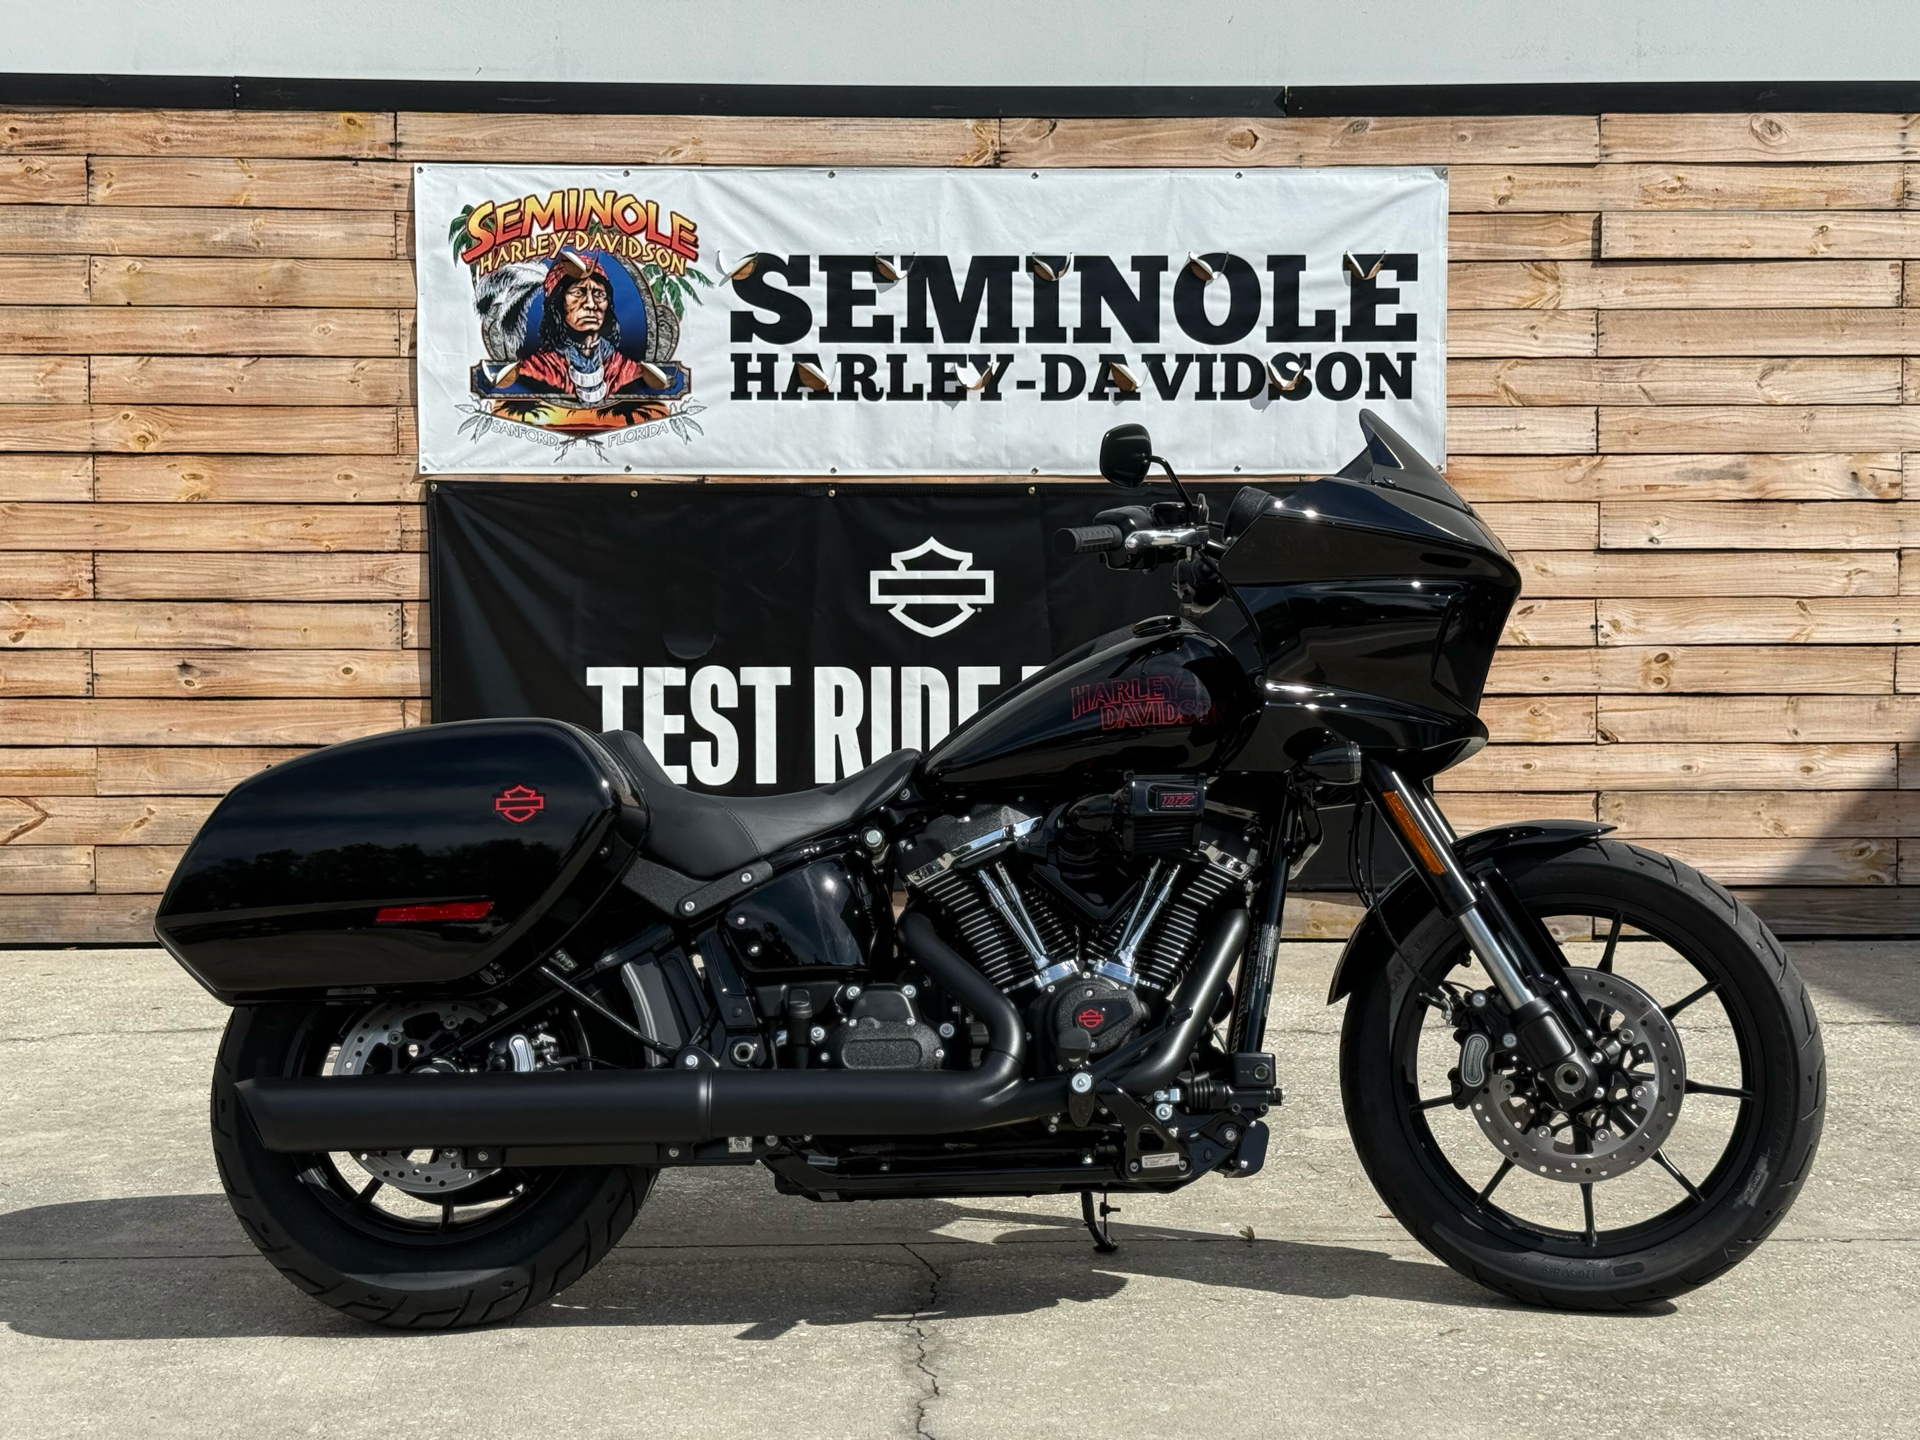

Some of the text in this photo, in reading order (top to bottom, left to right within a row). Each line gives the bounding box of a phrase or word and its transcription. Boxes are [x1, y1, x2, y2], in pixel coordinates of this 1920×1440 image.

[461, 188, 700, 263] SEMINOLE
[478, 231, 687, 277] HARLEY-DAVIDSON
[730, 253, 1418, 345] SEMINOLE
[730, 352, 1415, 402] HARLEY-DAVIDSON
[608, 422, 669, 448] FLORIDA
[1071, 676, 1199, 719] HARLEY-
[1100, 699, 1229, 731] DAVIDSON
[585, 665, 792, 786] TEST
